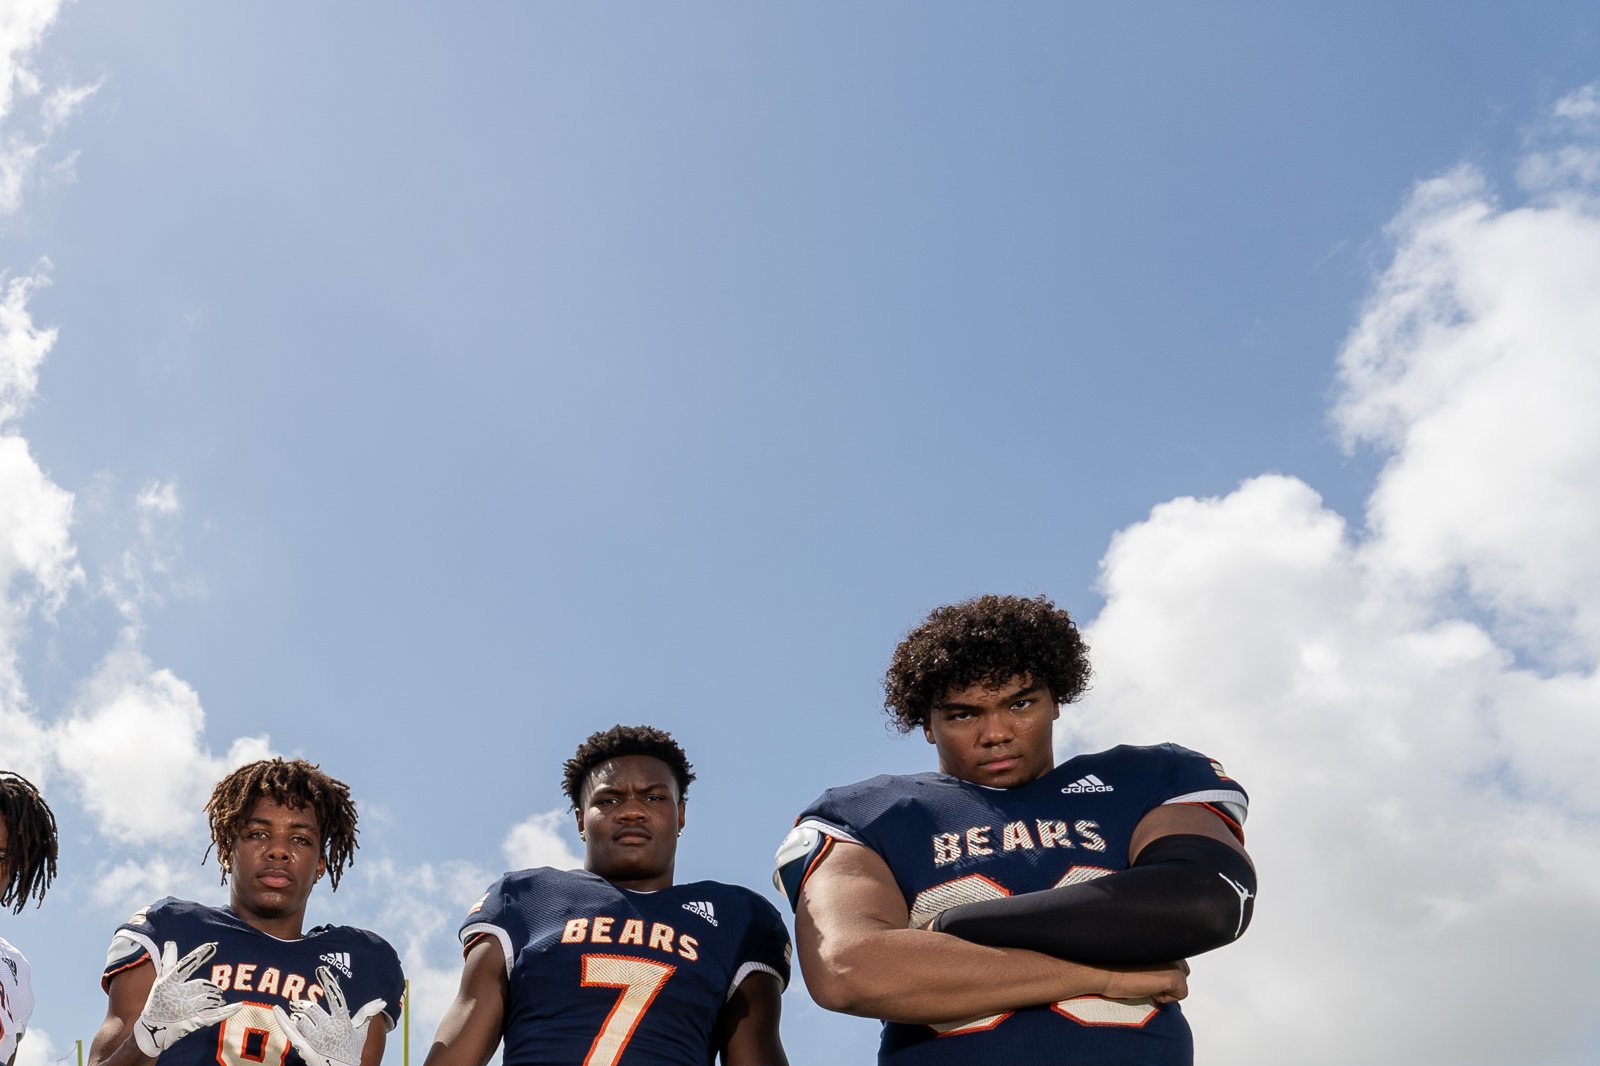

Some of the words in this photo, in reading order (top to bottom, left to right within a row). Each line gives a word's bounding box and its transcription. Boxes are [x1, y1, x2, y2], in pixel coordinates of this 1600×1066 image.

[1060, 784, 1114, 795] adidas
[932, 818, 1107, 868] BEARS
[681, 901, 719, 927] adidas
[561, 916, 700, 961] BEARS
[318, 953, 353, 979] adidas
[211, 962, 324, 1006] BEARS
